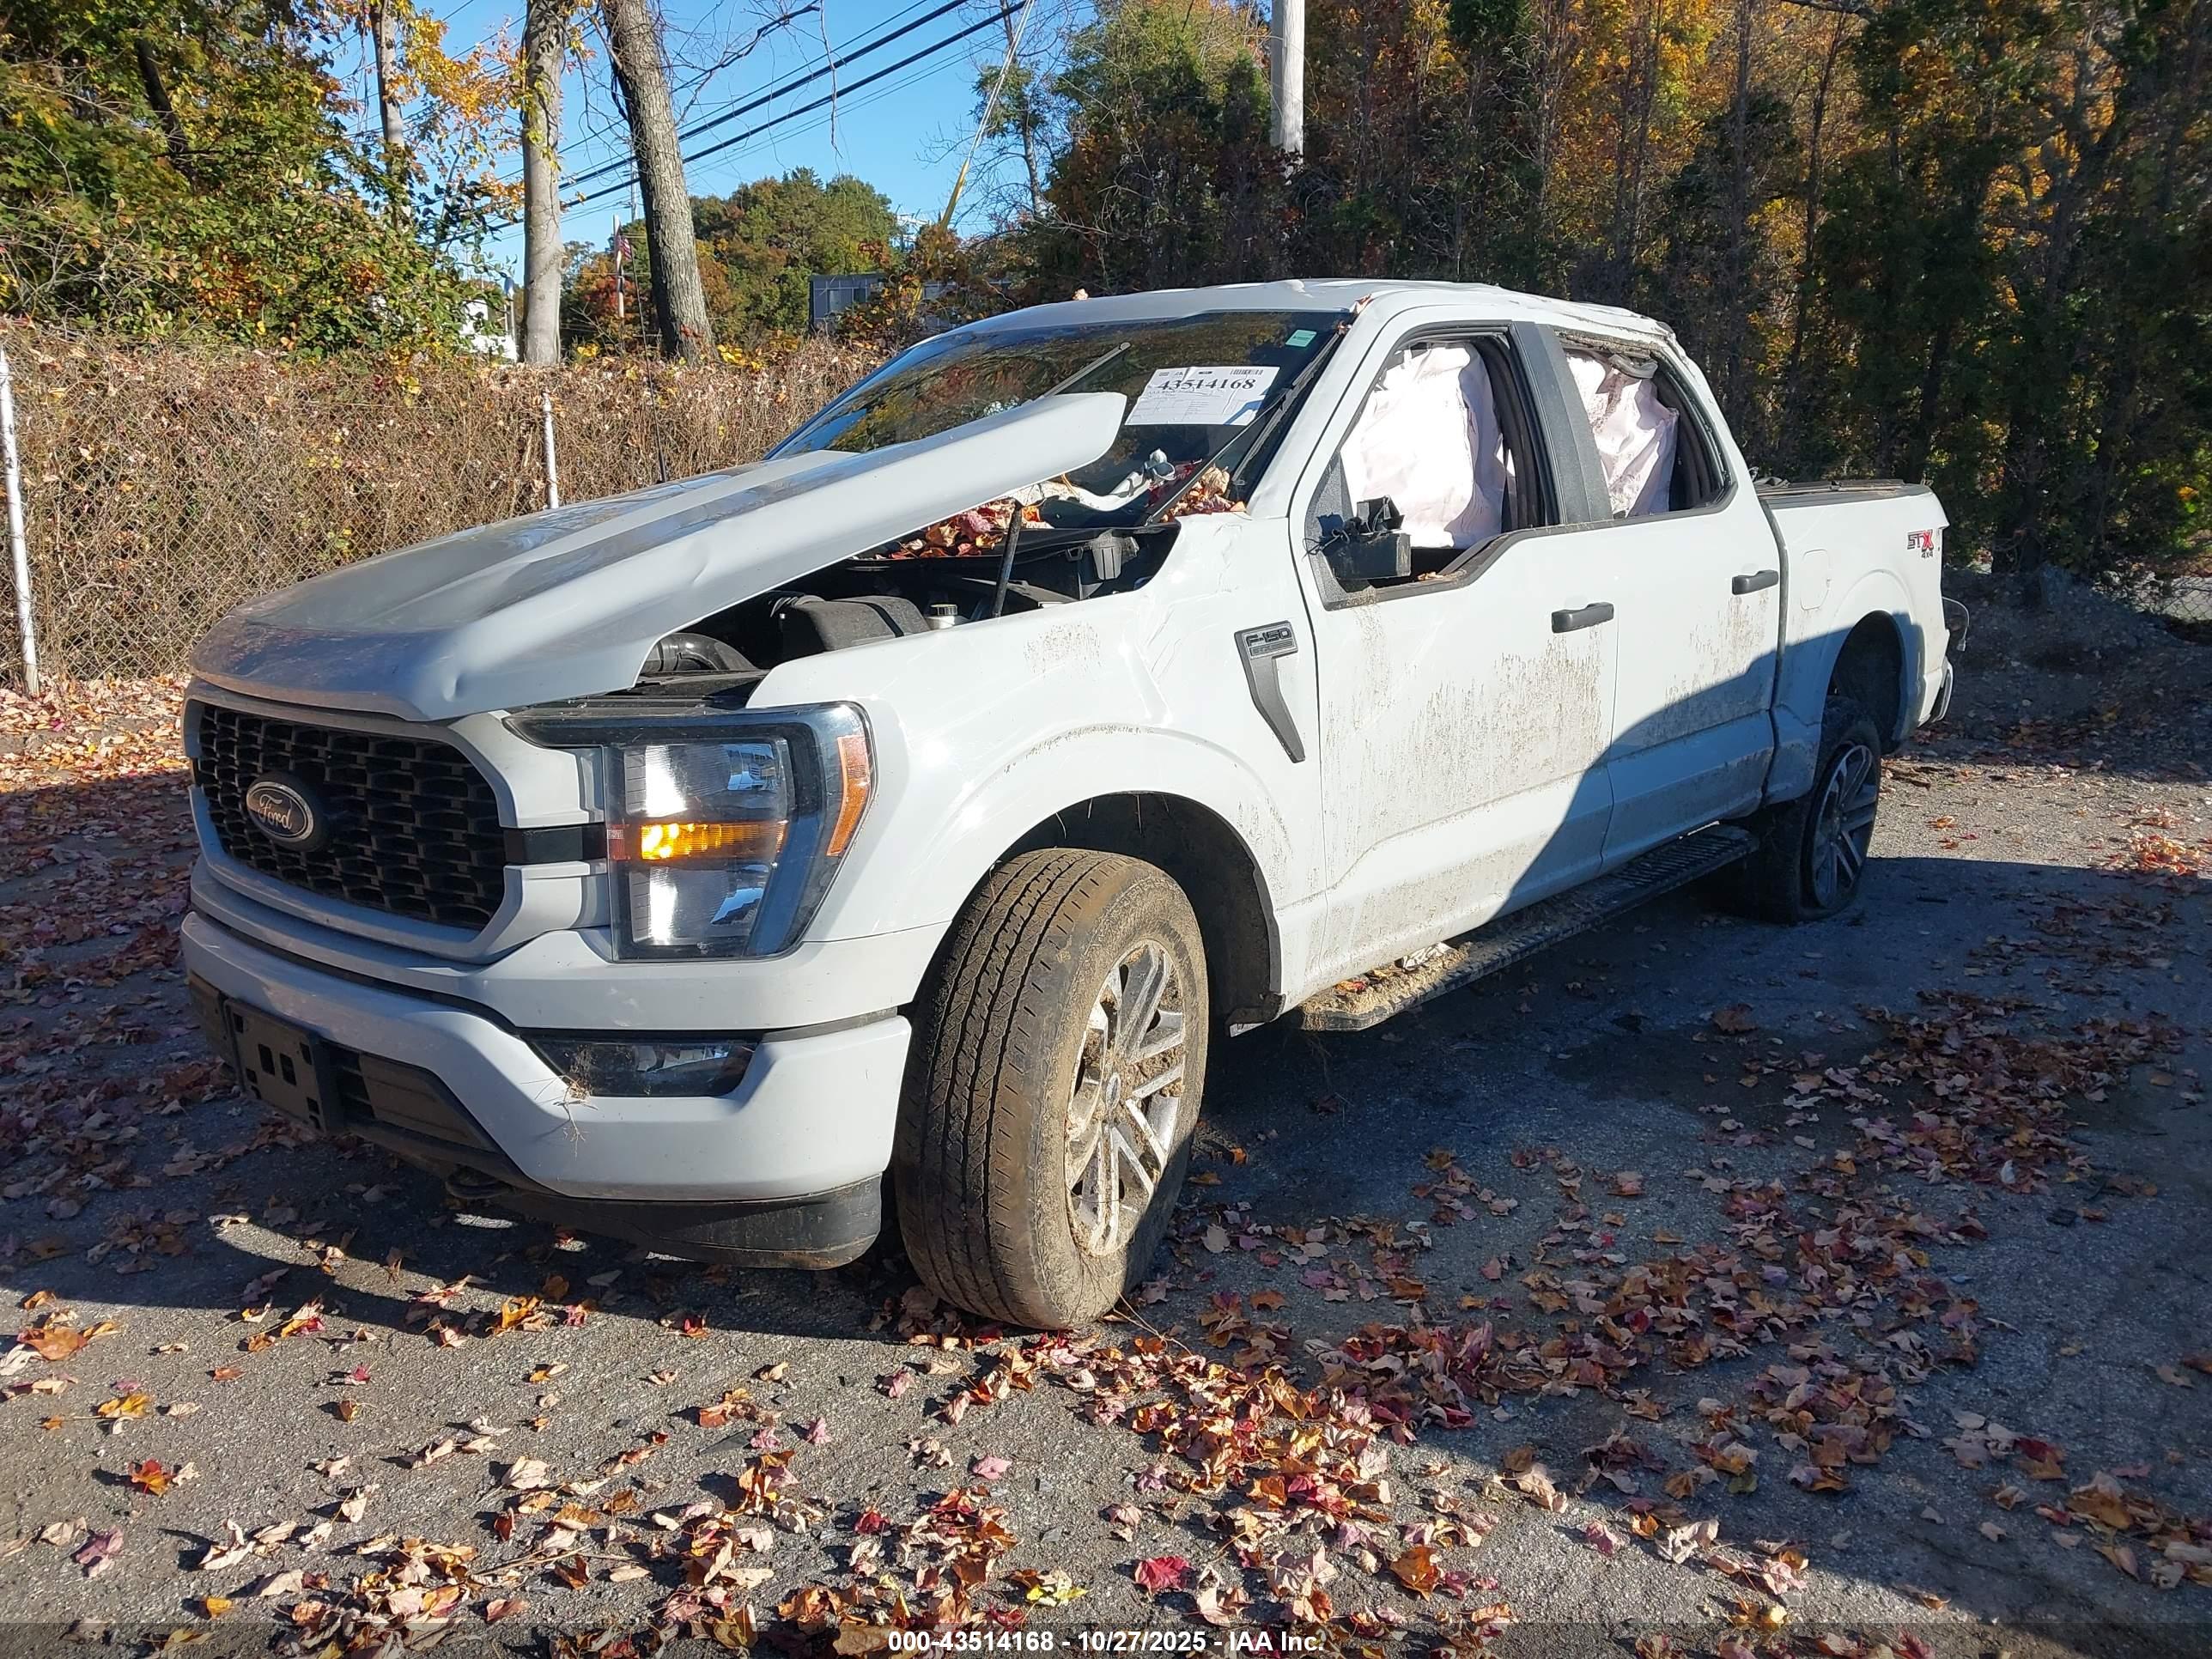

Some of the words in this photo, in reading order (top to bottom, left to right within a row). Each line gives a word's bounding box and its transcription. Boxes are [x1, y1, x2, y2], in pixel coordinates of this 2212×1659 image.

[1157, 378, 1256, 391] 43514168
[1907, 529, 1934, 552] STX
[1246, 627, 1292, 647] F-150
[258, 793, 293, 830] Ford
